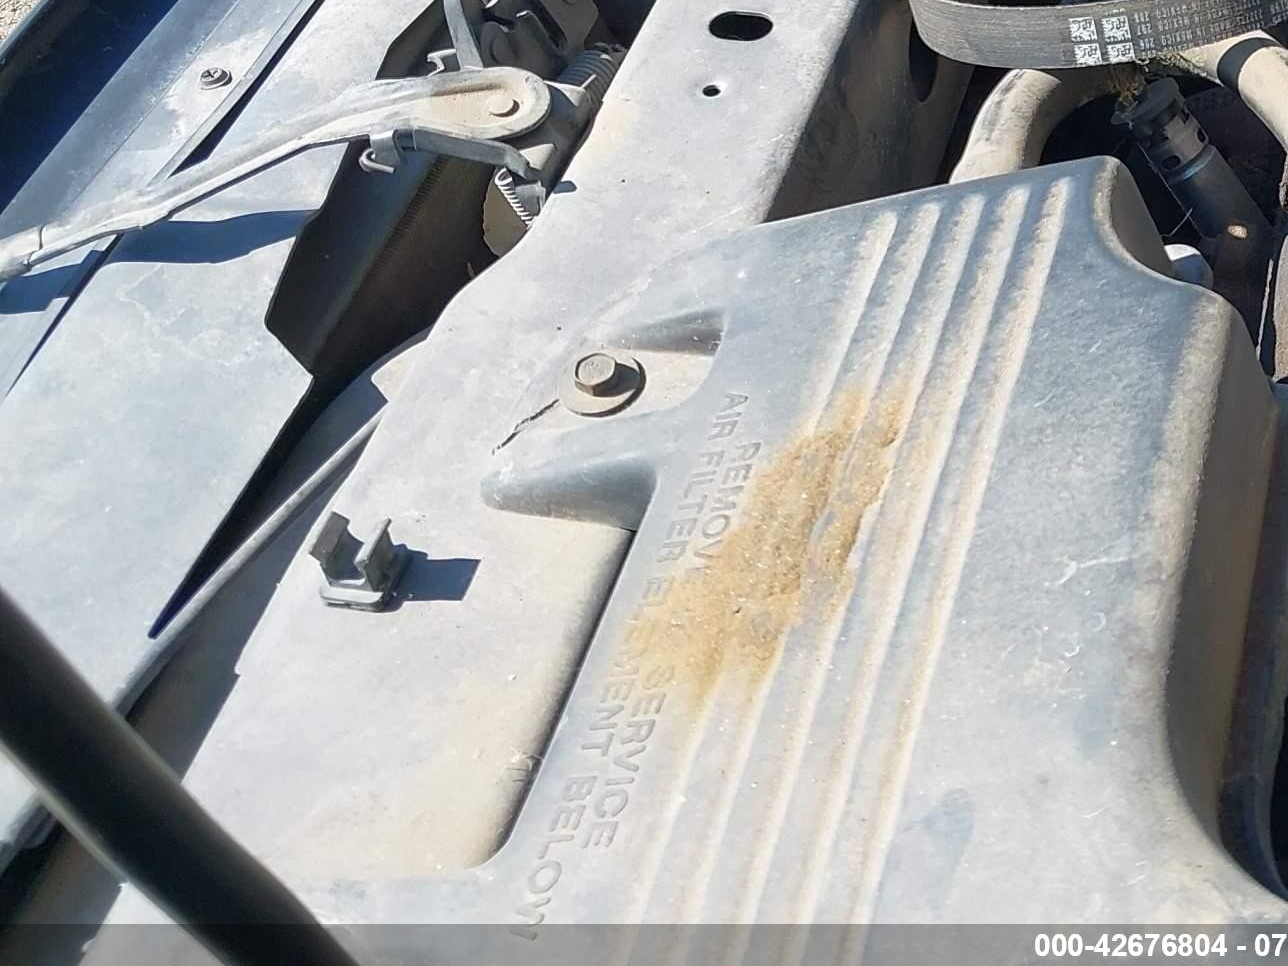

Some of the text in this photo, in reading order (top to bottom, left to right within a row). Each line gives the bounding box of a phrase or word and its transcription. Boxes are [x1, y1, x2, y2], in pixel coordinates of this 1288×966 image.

[1156, 3, 1186, 18] MEXICO
[1157, 16, 1190, 31] MEXICO
[1160, 30, 1192, 45] MEXICO
[707, 394, 749, 440] AIR
[656, 451, 726, 561] FILTER
[582, 668, 675, 850] SERVICE
[510, 775, 595, 943] BELOW
